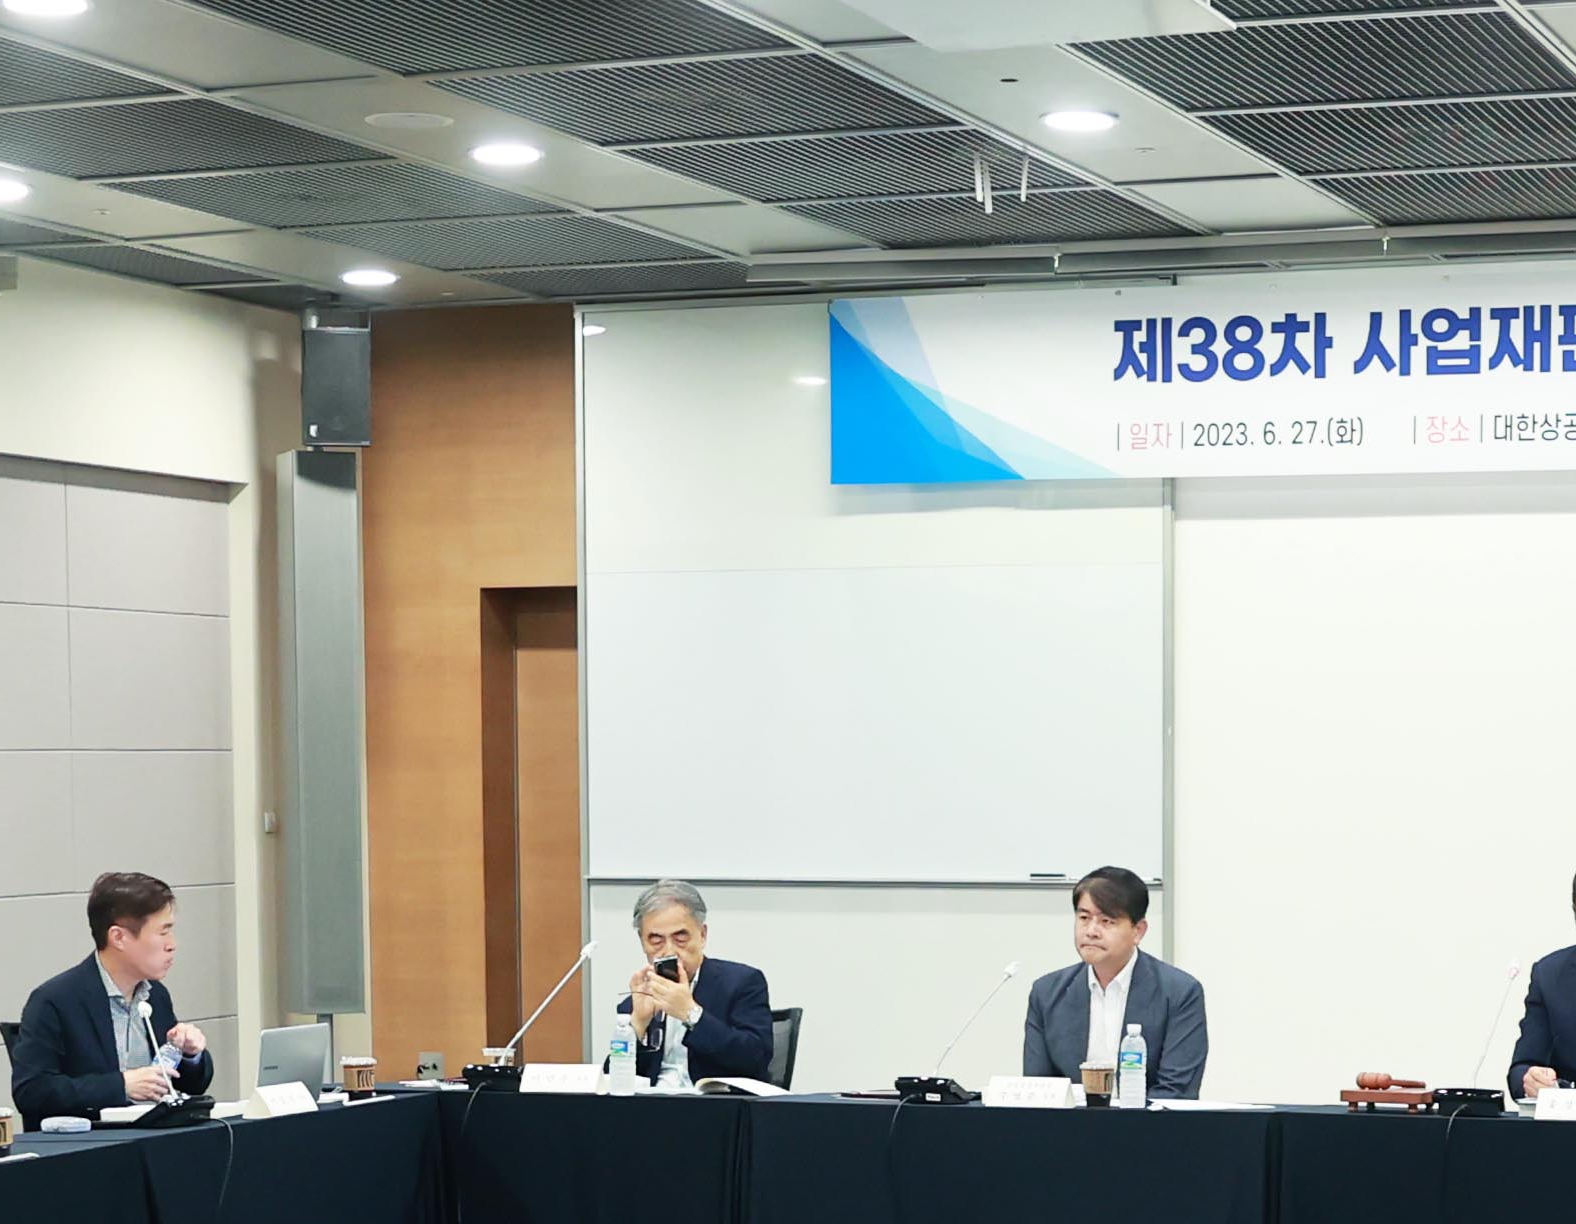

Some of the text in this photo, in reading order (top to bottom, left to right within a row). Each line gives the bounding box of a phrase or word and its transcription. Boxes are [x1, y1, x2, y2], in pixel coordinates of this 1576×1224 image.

[1113, 311, 1334, 384] 제38차
[1129, 422, 1172, 451] 일자
[1192, 416, 1364, 448] 2023. 6. 27.(화)
[1426, 415, 1470, 444] 장소
